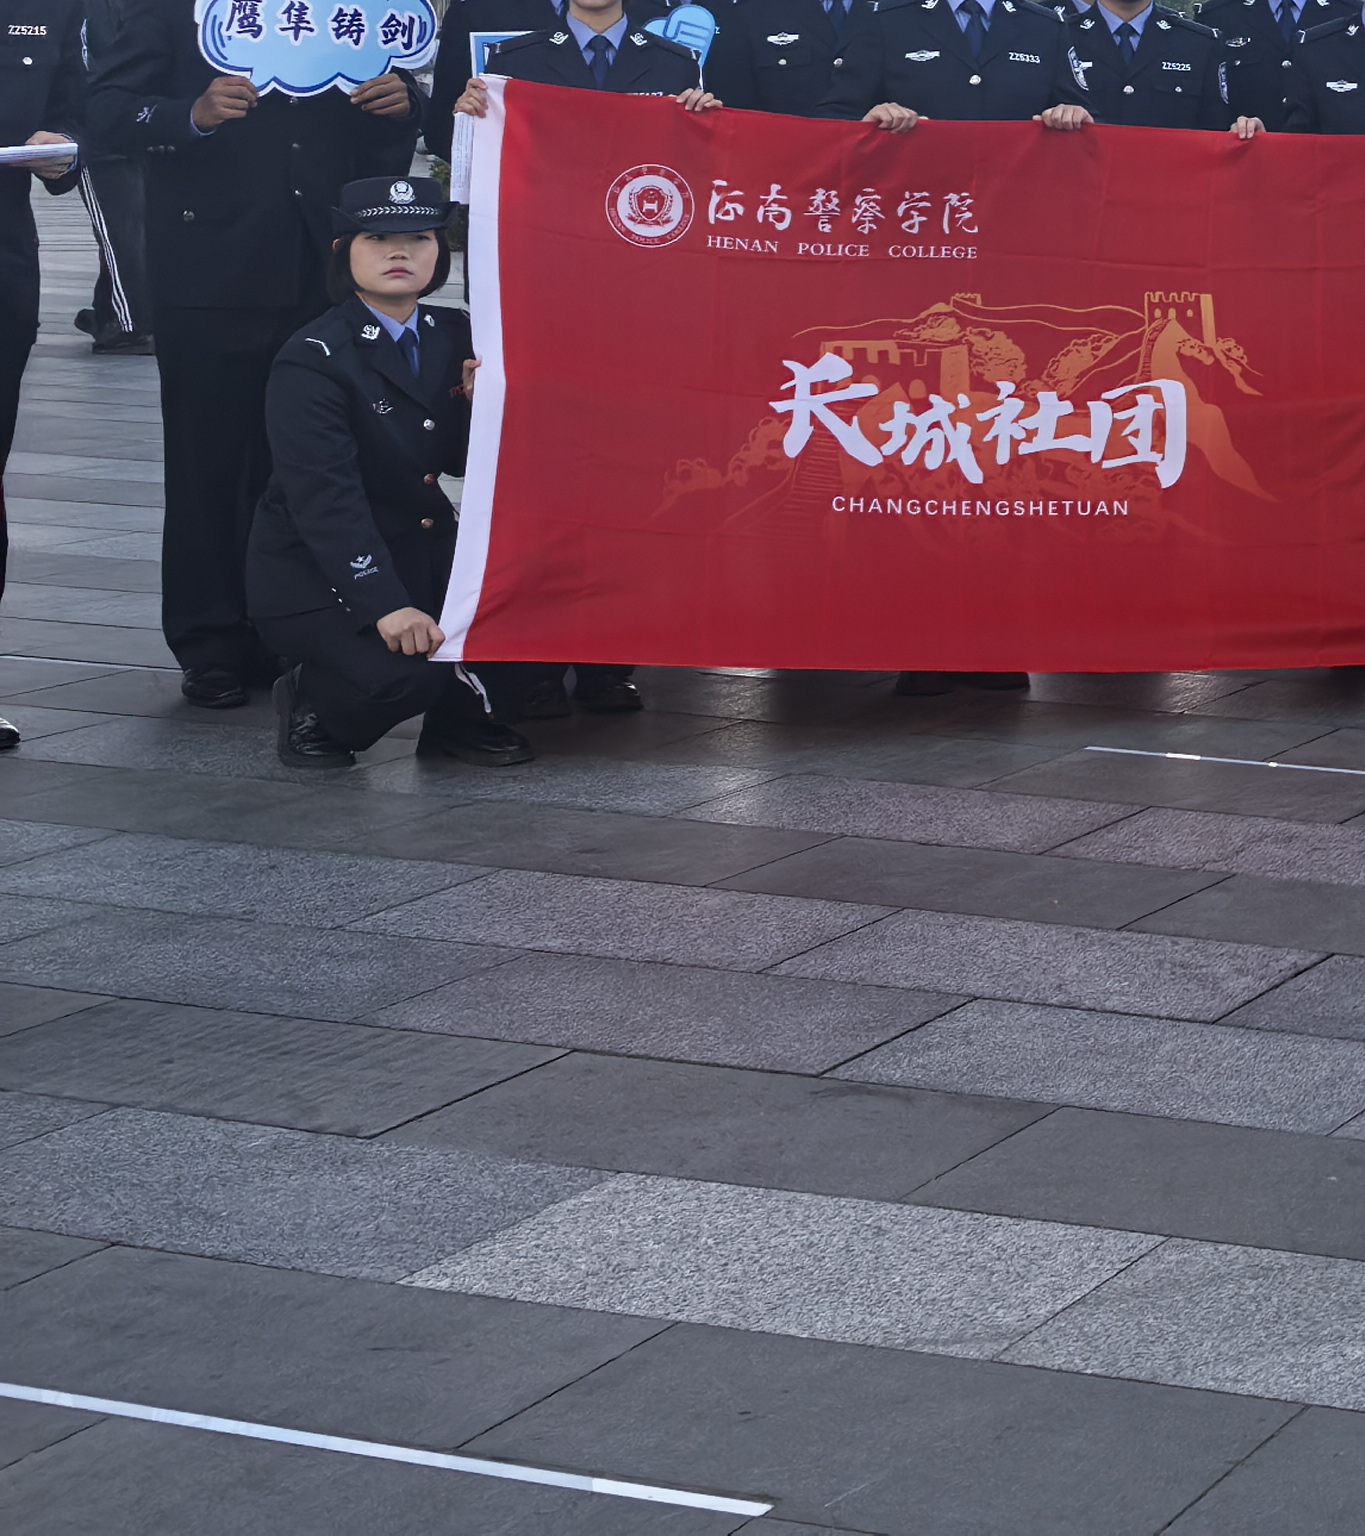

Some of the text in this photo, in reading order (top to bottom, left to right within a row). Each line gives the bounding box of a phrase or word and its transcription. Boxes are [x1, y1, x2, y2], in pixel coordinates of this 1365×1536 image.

[707, 179, 979, 235] 河南警察学院
[706, 235, 979, 260] HENAN POLICE COLLEGE
[768, 352, 1187, 489] 长城社团
[831, 495, 1130, 517] CHANGCHENGSHETUAN
